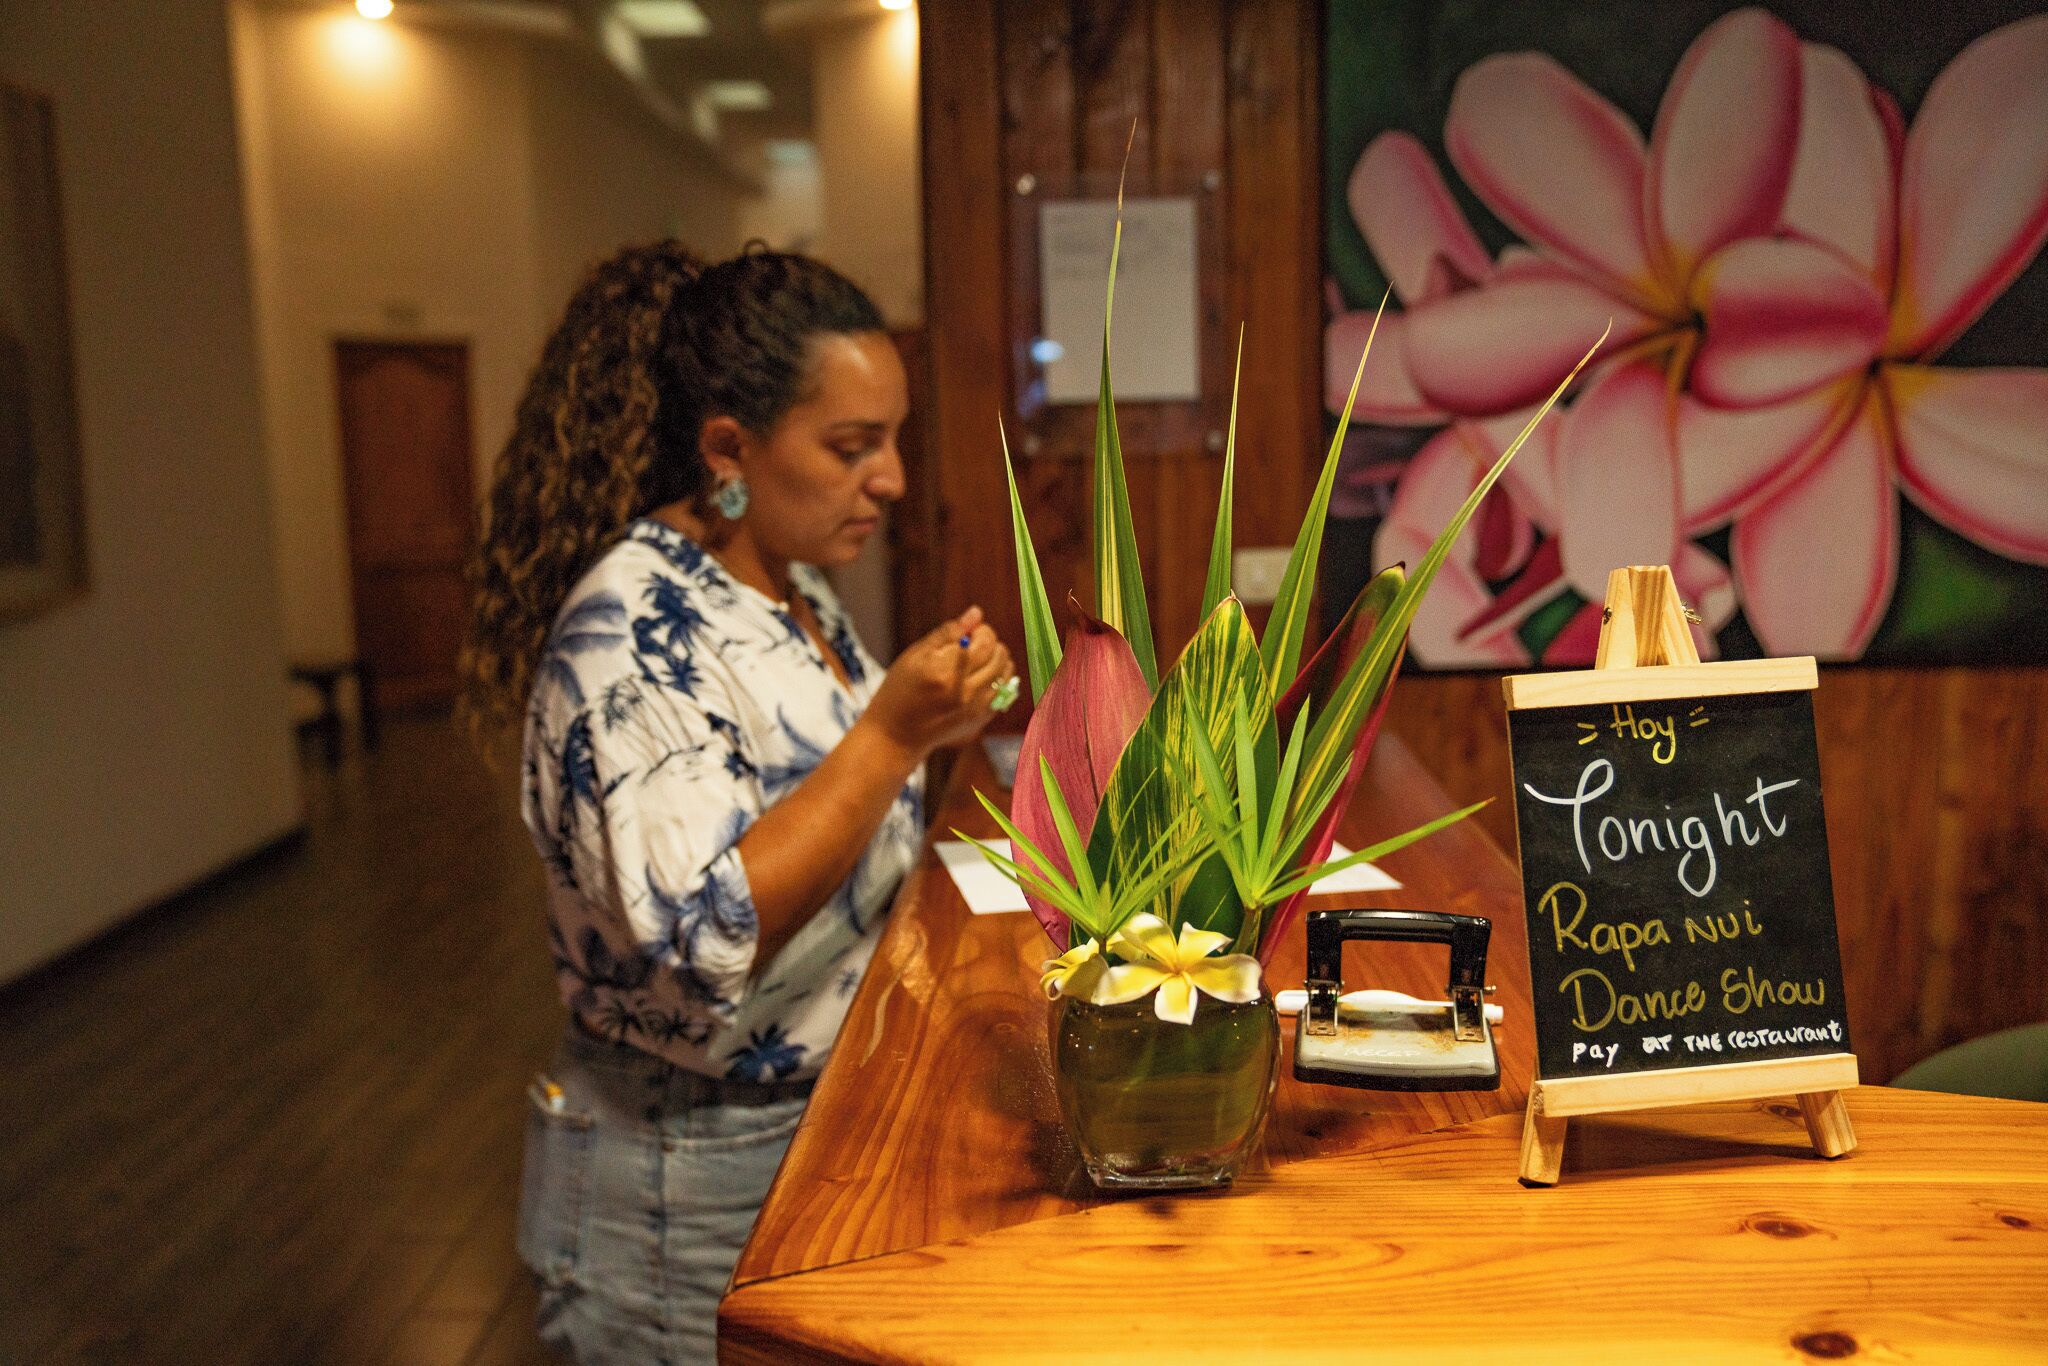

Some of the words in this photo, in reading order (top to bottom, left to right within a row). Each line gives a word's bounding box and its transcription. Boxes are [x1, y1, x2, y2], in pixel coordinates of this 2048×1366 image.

[1610, 705, 1676, 764] Hoy
[1523, 758, 1800, 897] Tonight
[1538, 881, 1670, 972] Rapa
[1559, 968, 1706, 1032] Dance
[1720, 966, 1826, 1014] Show
